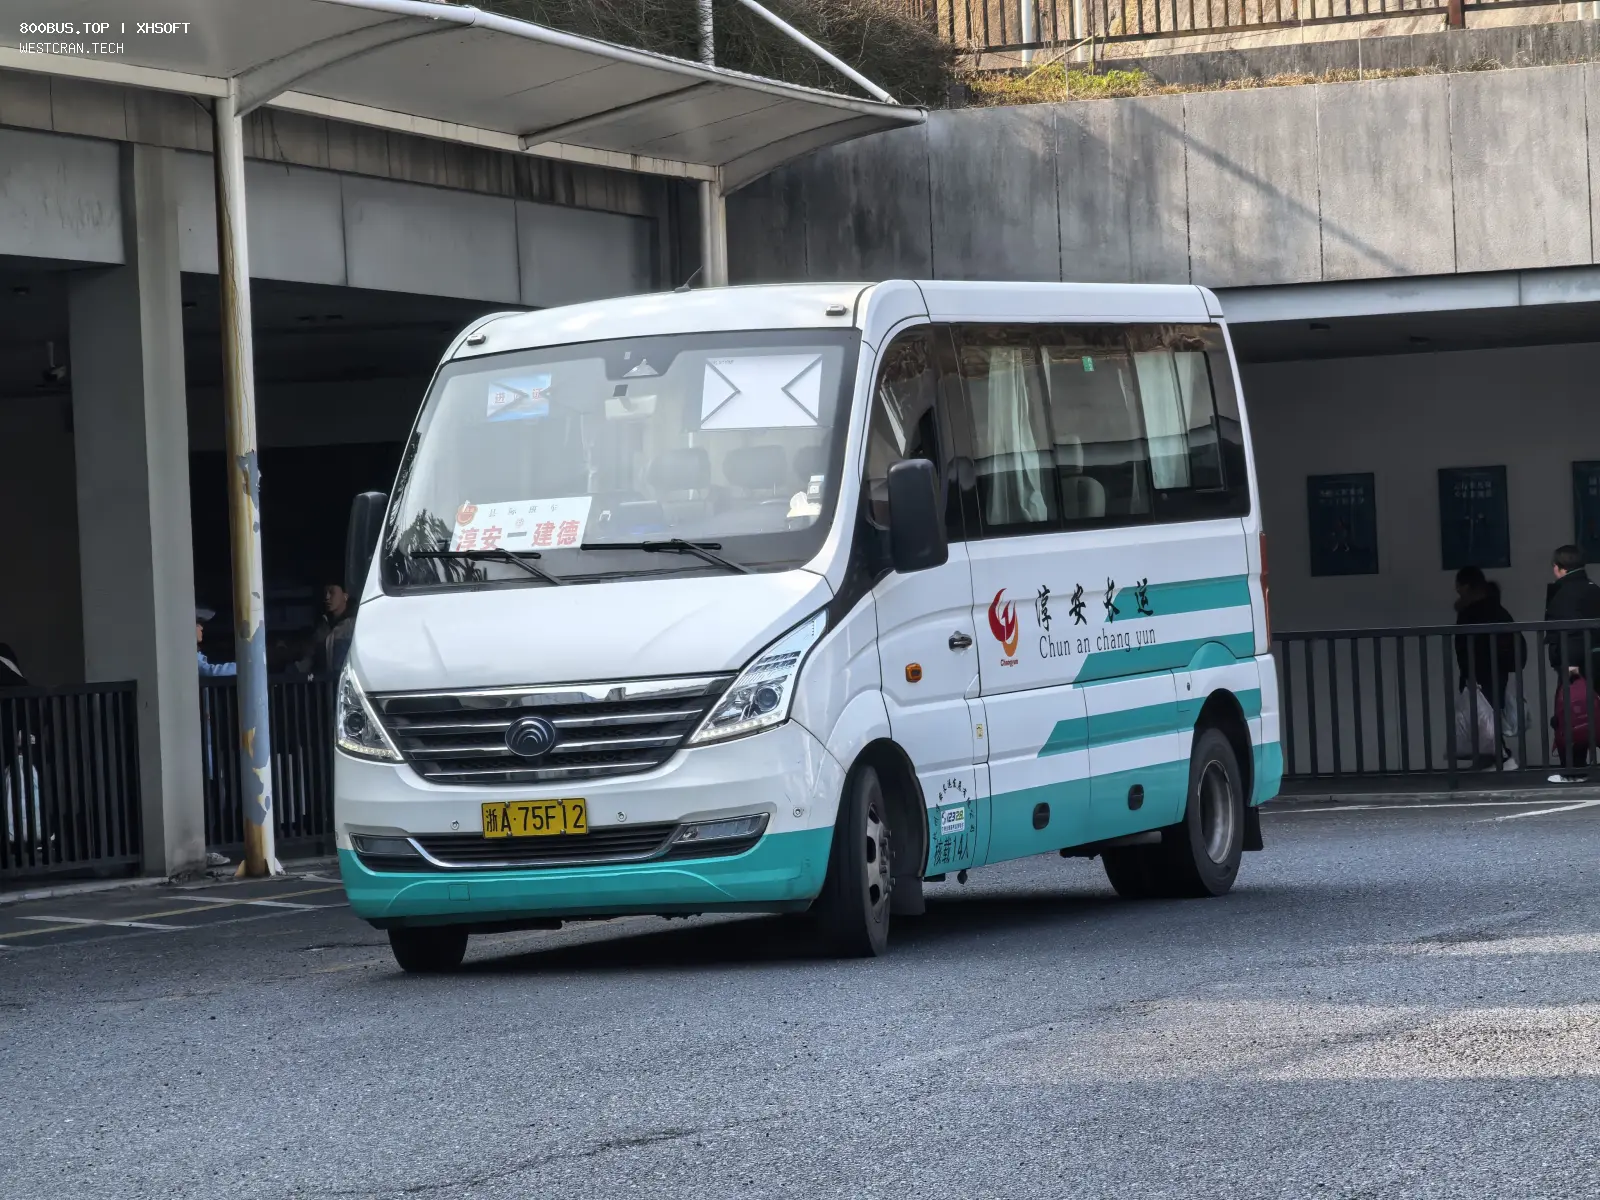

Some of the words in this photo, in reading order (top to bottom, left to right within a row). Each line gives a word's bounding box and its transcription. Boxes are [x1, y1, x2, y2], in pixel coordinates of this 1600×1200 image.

[1039, 635, 1071, 659] Chun
[1077, 640, 1091, 654] an
[1096, 628, 1131, 652] chang
[1136, 627, 1156, 651] yun
